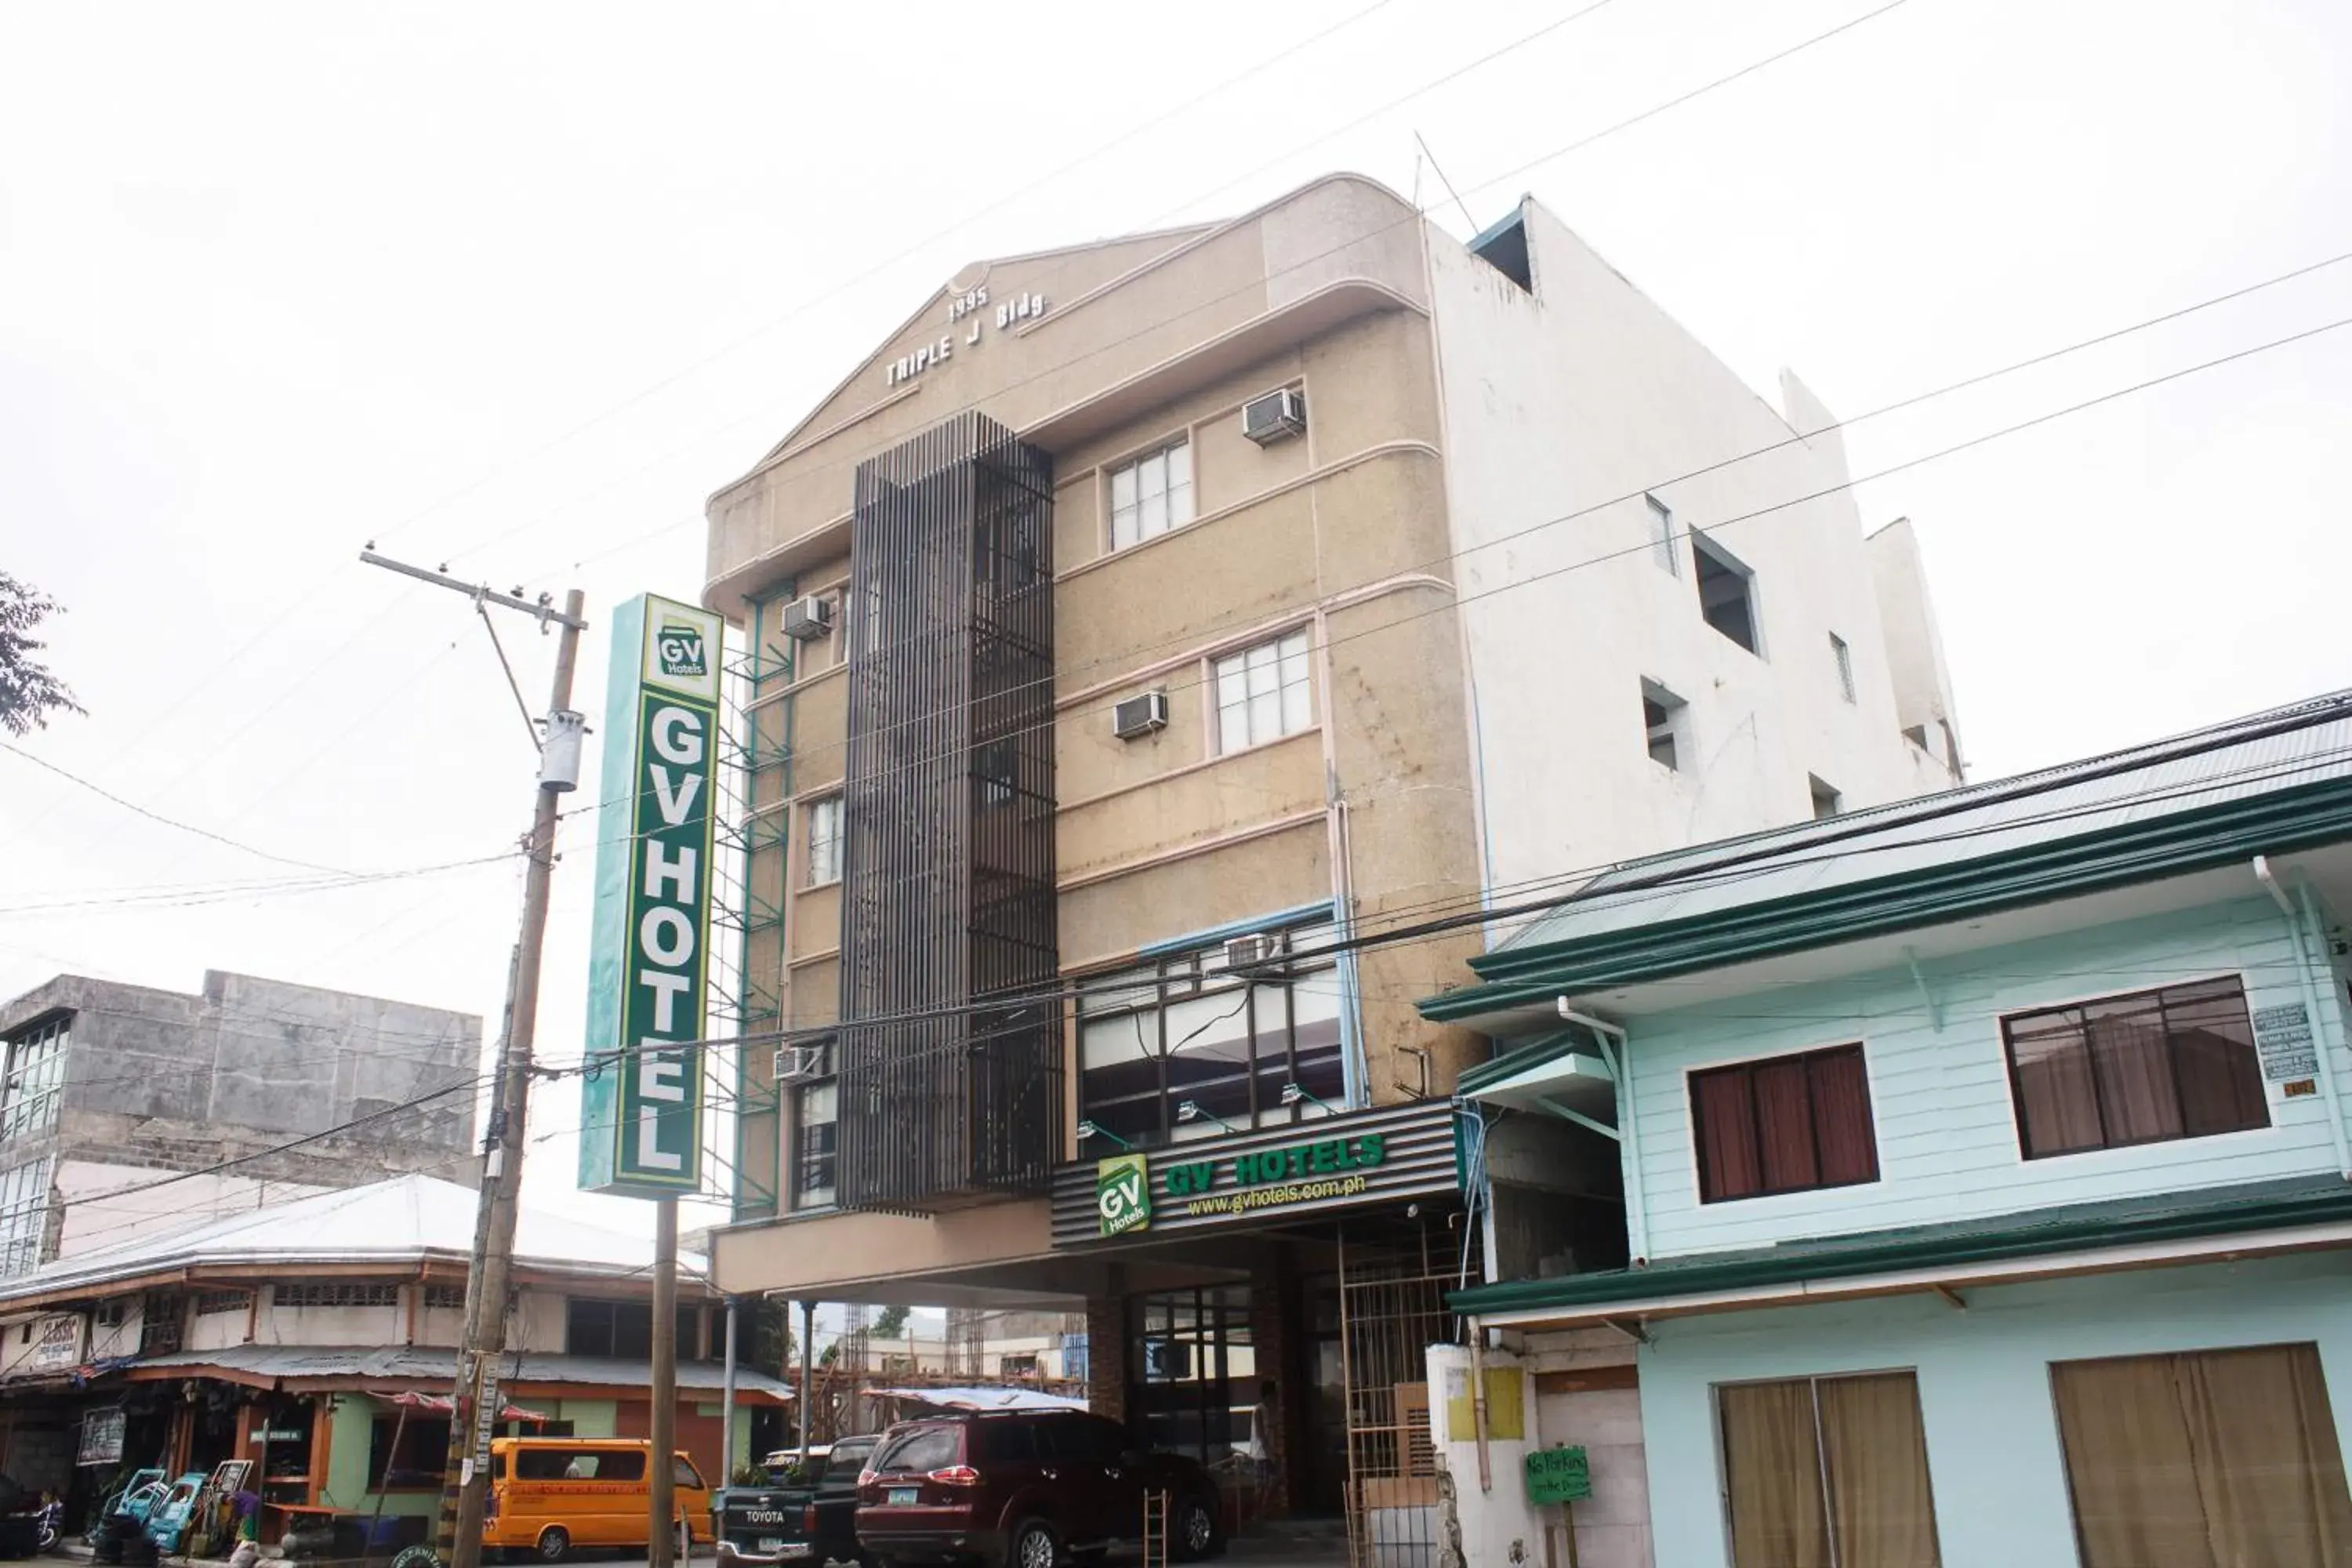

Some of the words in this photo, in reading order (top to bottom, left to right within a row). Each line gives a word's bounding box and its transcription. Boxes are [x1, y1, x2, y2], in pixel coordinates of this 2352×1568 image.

[949, 286, 988, 322] 1995
[886, 335, 953, 387] TRIPLE
[966, 319, 979, 346] J
[661, 638, 702, 662] GV
[668, 662, 703, 674] Hotels
[1165, 1160, 1215, 1196] GV
[1236, 1134, 1385, 1186] HOTELS
[1100, 1174, 1140, 1218] GV
[1189, 1174, 1366, 1216] www.gvhotels.com.ph
[1109, 1206, 1145, 1233] Hotels
[746, 1511, 783, 1523] TOYOTA
